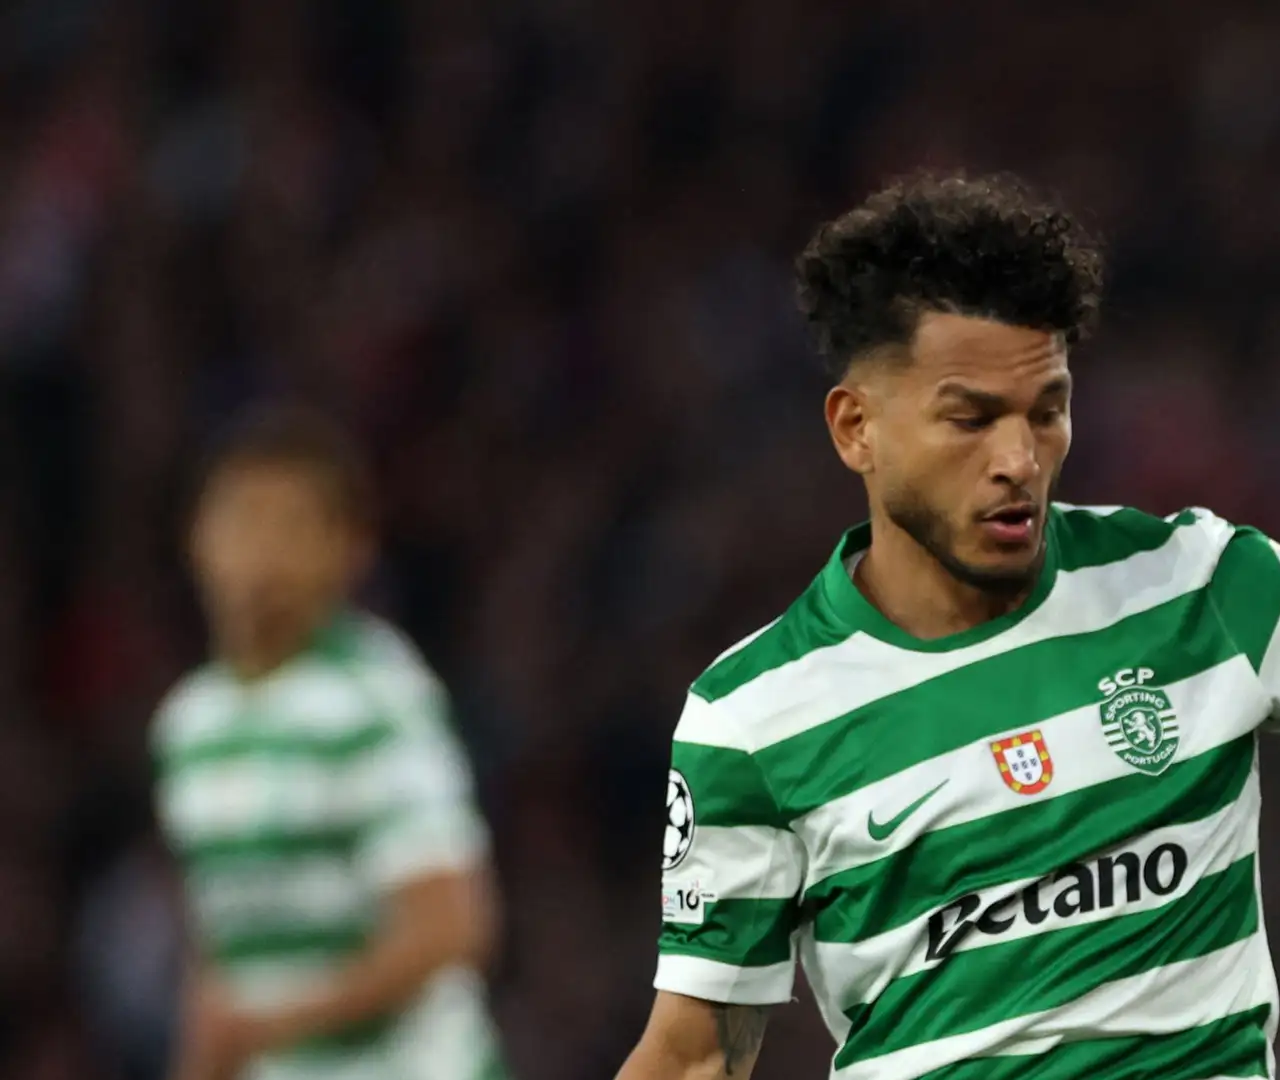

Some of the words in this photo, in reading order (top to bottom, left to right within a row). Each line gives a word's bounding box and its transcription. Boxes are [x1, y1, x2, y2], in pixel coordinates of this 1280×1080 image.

[1098, 667, 1155, 696] SCP
[1105, 692, 1166, 721] SPORTING
[1123, 743, 1177, 765] PORTUGAL
[924, 842, 1188, 963] Betano
